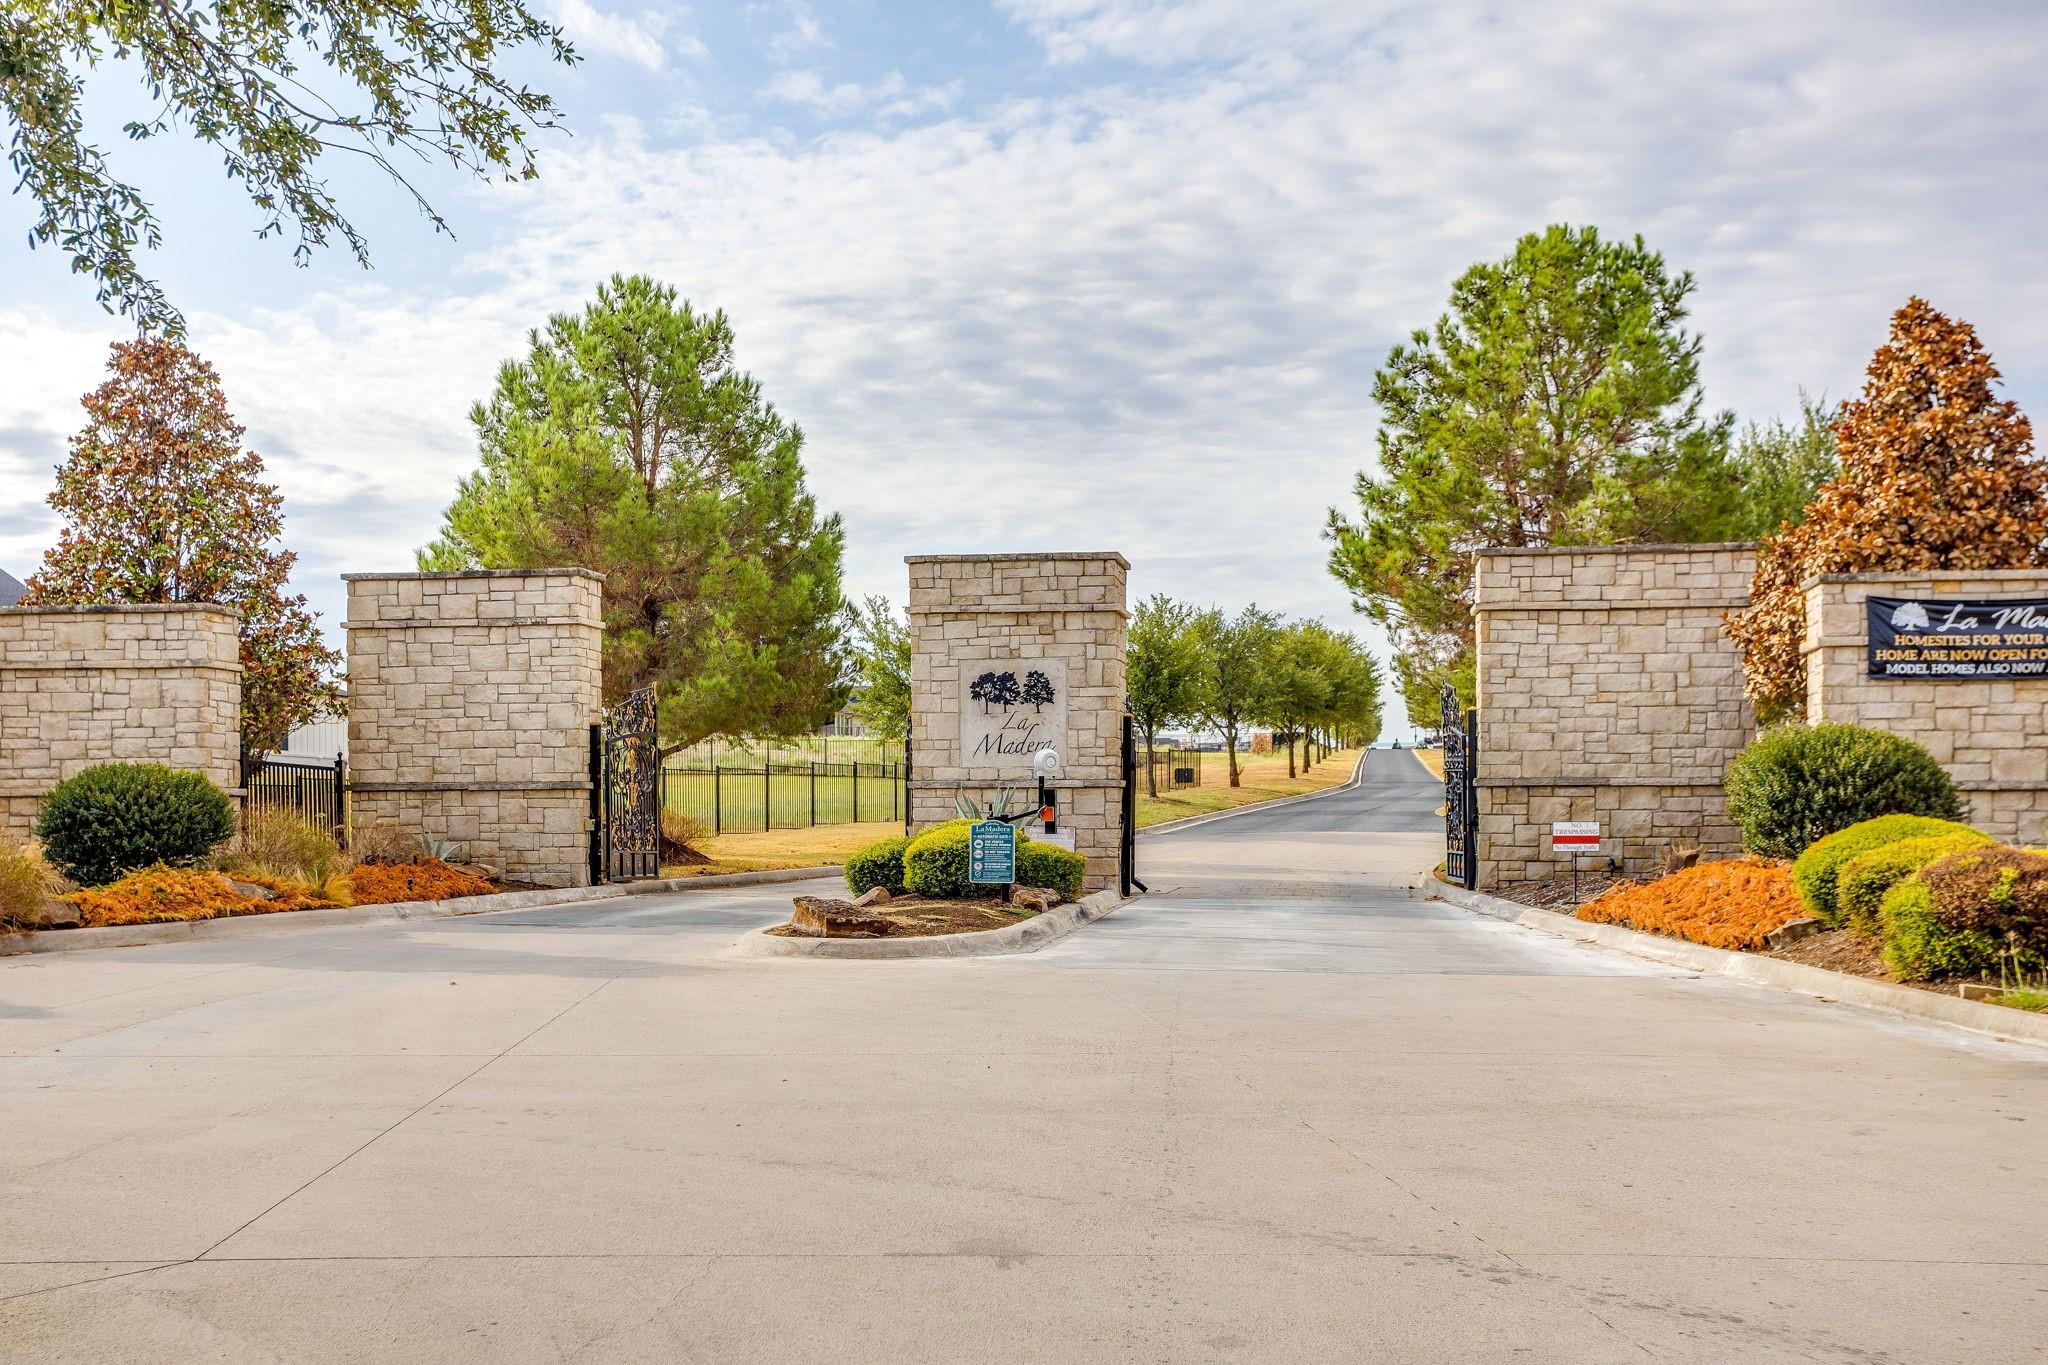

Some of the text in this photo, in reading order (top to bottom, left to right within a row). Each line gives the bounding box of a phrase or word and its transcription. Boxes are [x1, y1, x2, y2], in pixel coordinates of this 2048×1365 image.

[1936, 603, 2048, 632] La Ma
[1894, 634, 1971, 646] HOMESITES
[1973, 634, 2000, 646] FOR
[2003, 633, 2045, 645] YOUR
[1875, 649, 1917, 661] HOME
[1919, 649, 1948, 661] ARE
[1950, 649, 1986, 661] NOW
[1989, 649, 2028, 661] OPEN
[1886, 663, 1929, 674] MODEL
[1930, 663, 1975, 674] HOMES
[1976, 663, 2011, 674] ALSO
[2012, 663, 2045, 673] NOW
[1000, 710, 1032, 731] La
